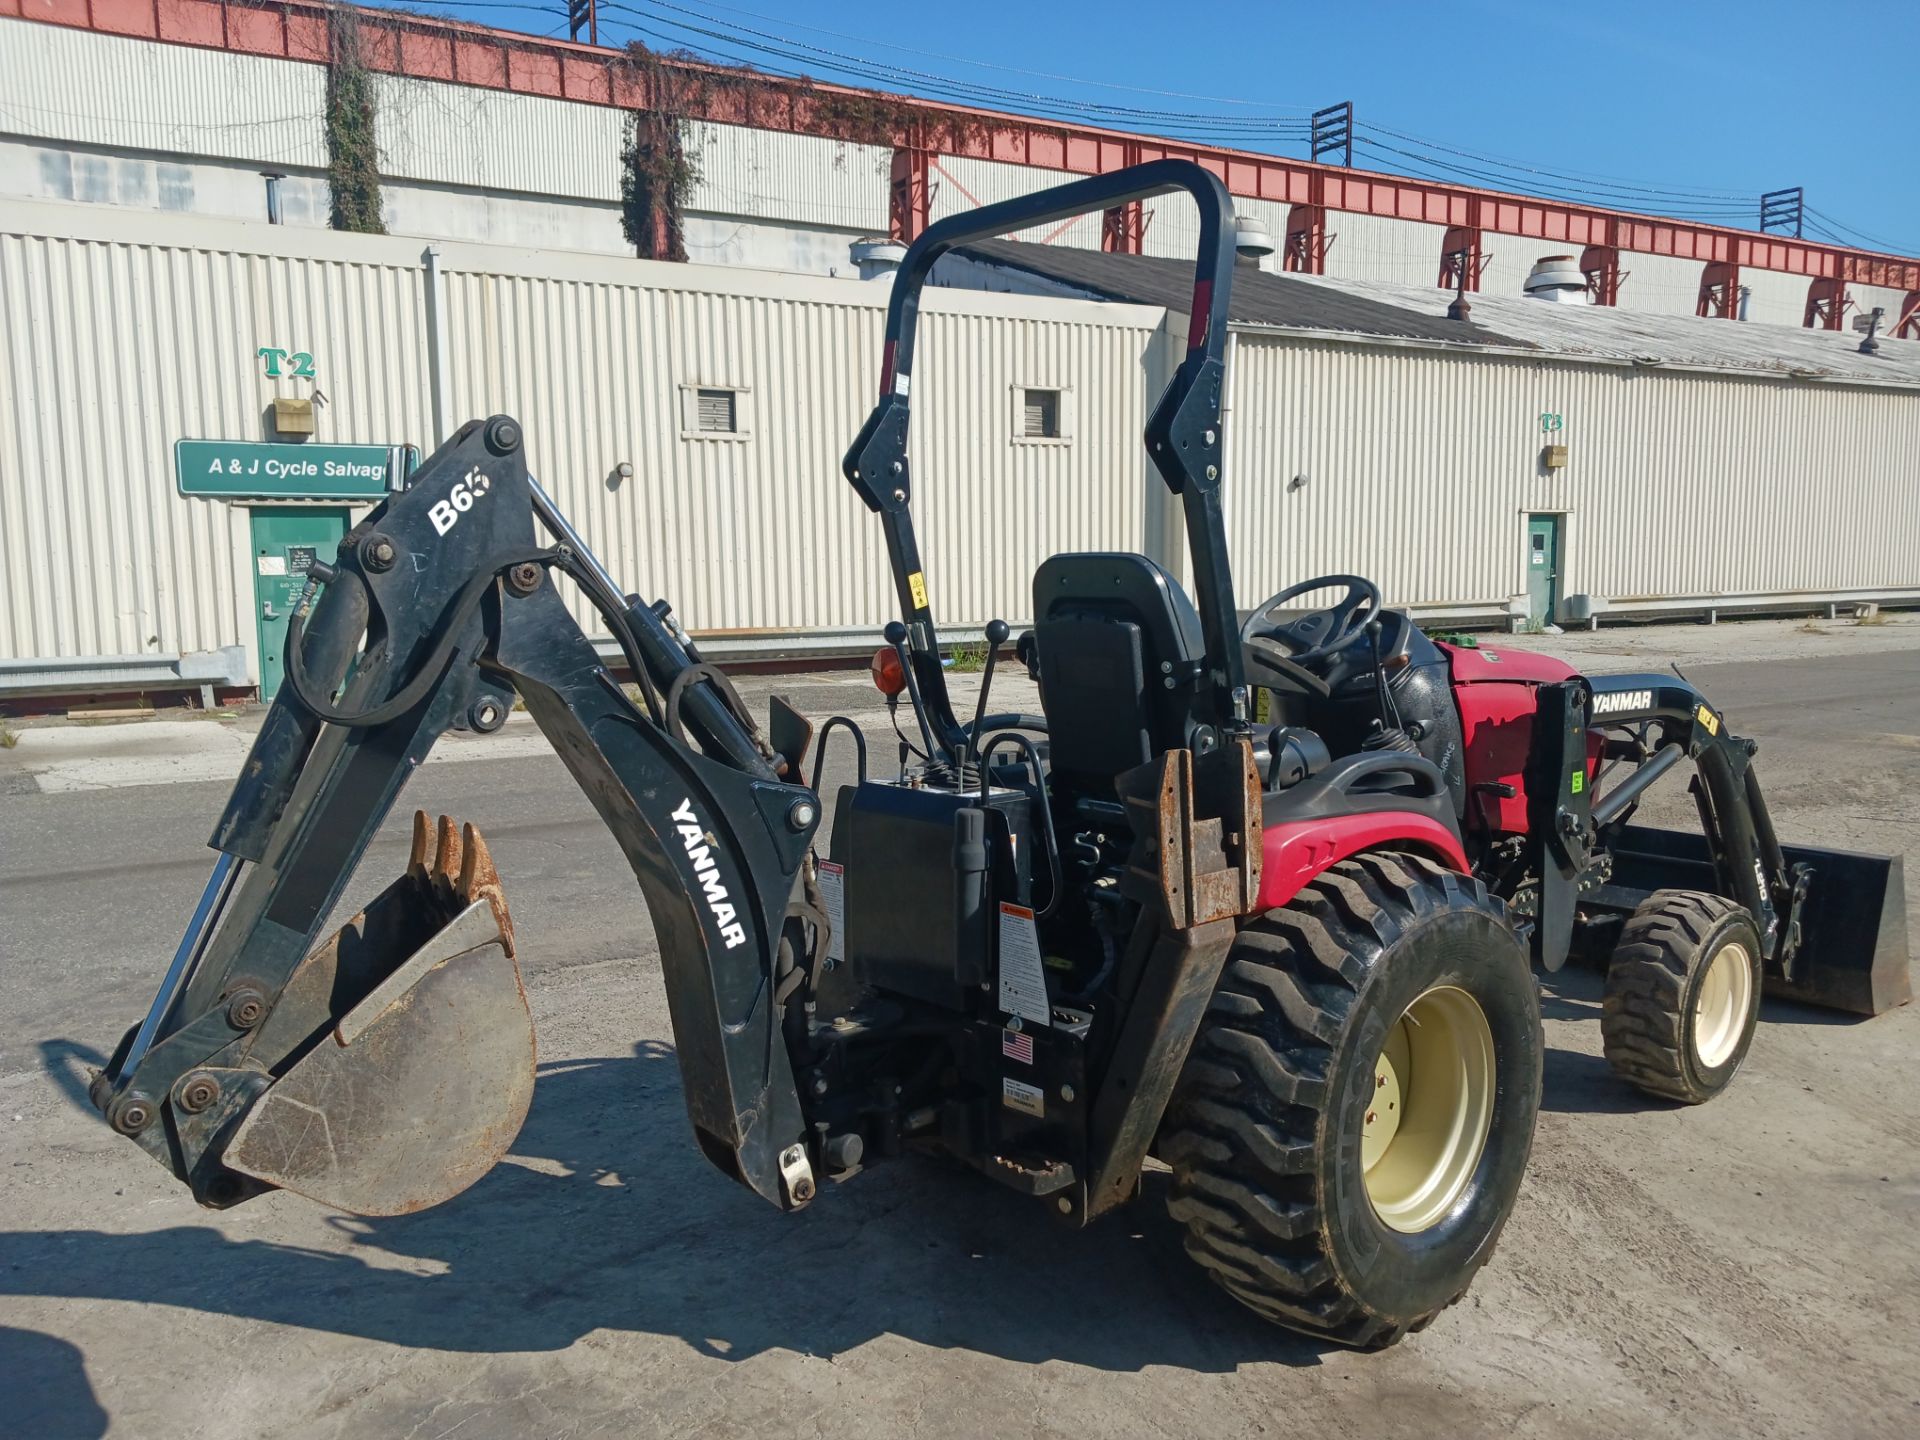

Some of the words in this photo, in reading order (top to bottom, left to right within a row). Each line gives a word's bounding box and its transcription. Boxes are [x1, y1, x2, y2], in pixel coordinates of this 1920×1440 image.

[257, 347, 316, 378] T2
[1541, 413, 1562, 430] T3
[209, 458, 223, 474] A
[229, 458, 242, 474] &
[248, 459, 259, 475] J
[265, 459, 318, 479] Cycle
[324, 460, 387, 480] Salvag
[1593, 690, 1652, 714] YANMAR
[671, 797, 747, 950] YANMAR
